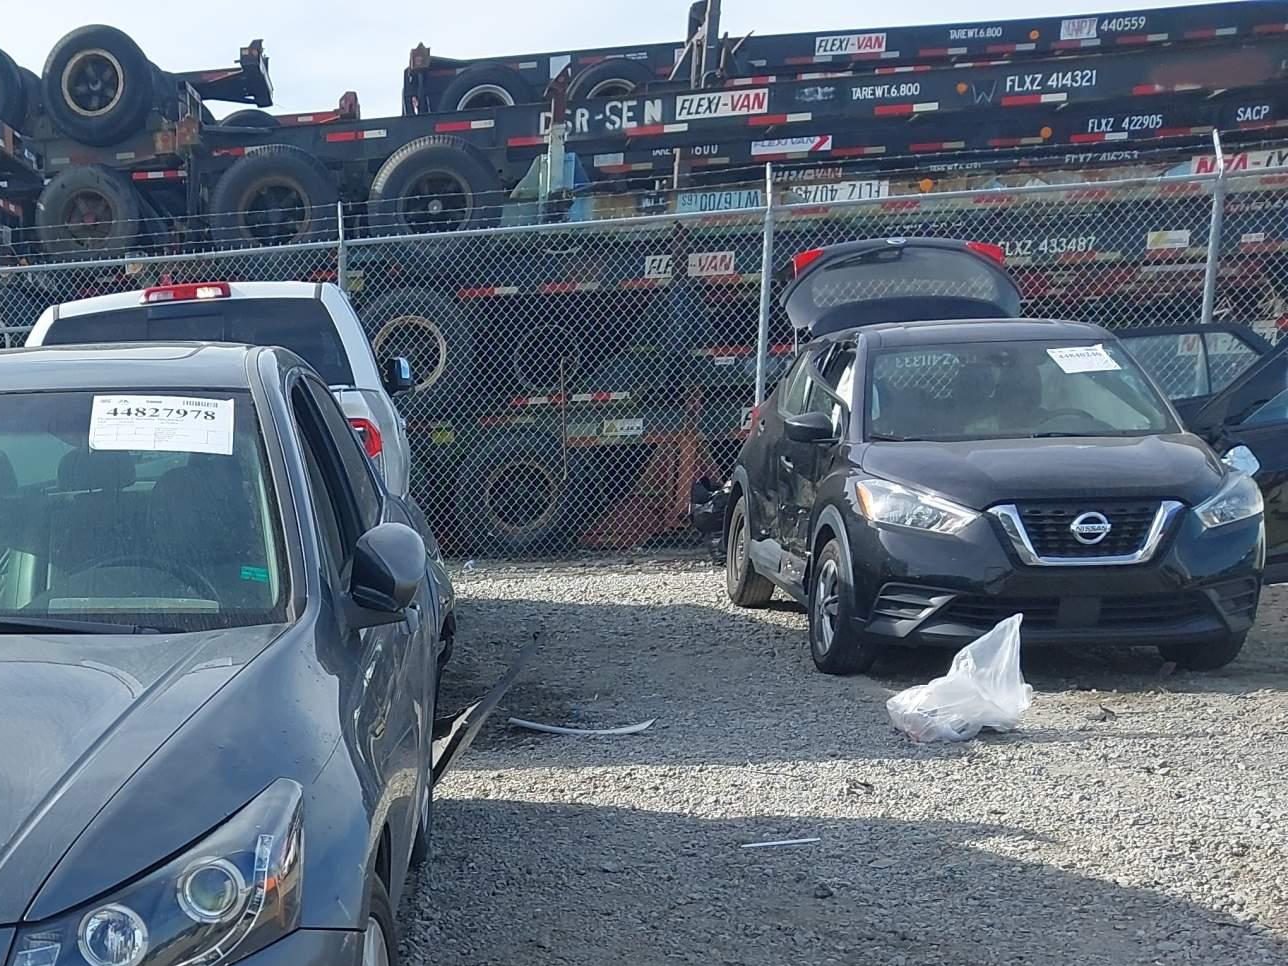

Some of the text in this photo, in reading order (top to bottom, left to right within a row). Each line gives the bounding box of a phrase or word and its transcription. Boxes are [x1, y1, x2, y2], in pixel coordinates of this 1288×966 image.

[1100, 16, 1146, 31] 440559
[817, 36, 885, 54] FLEXI-VAN
[1006, 69, 1097, 92] FLXZ 414321
[679, 92, 766, 116] FLEXI-VAN
[1236, 105, 1269, 122] SACP
[1088, 114, 1163, 133] FLXZ 422905
[998, 236, 1096, 256] FLXZ 433487
[107, 407, 216, 421] 44827978
